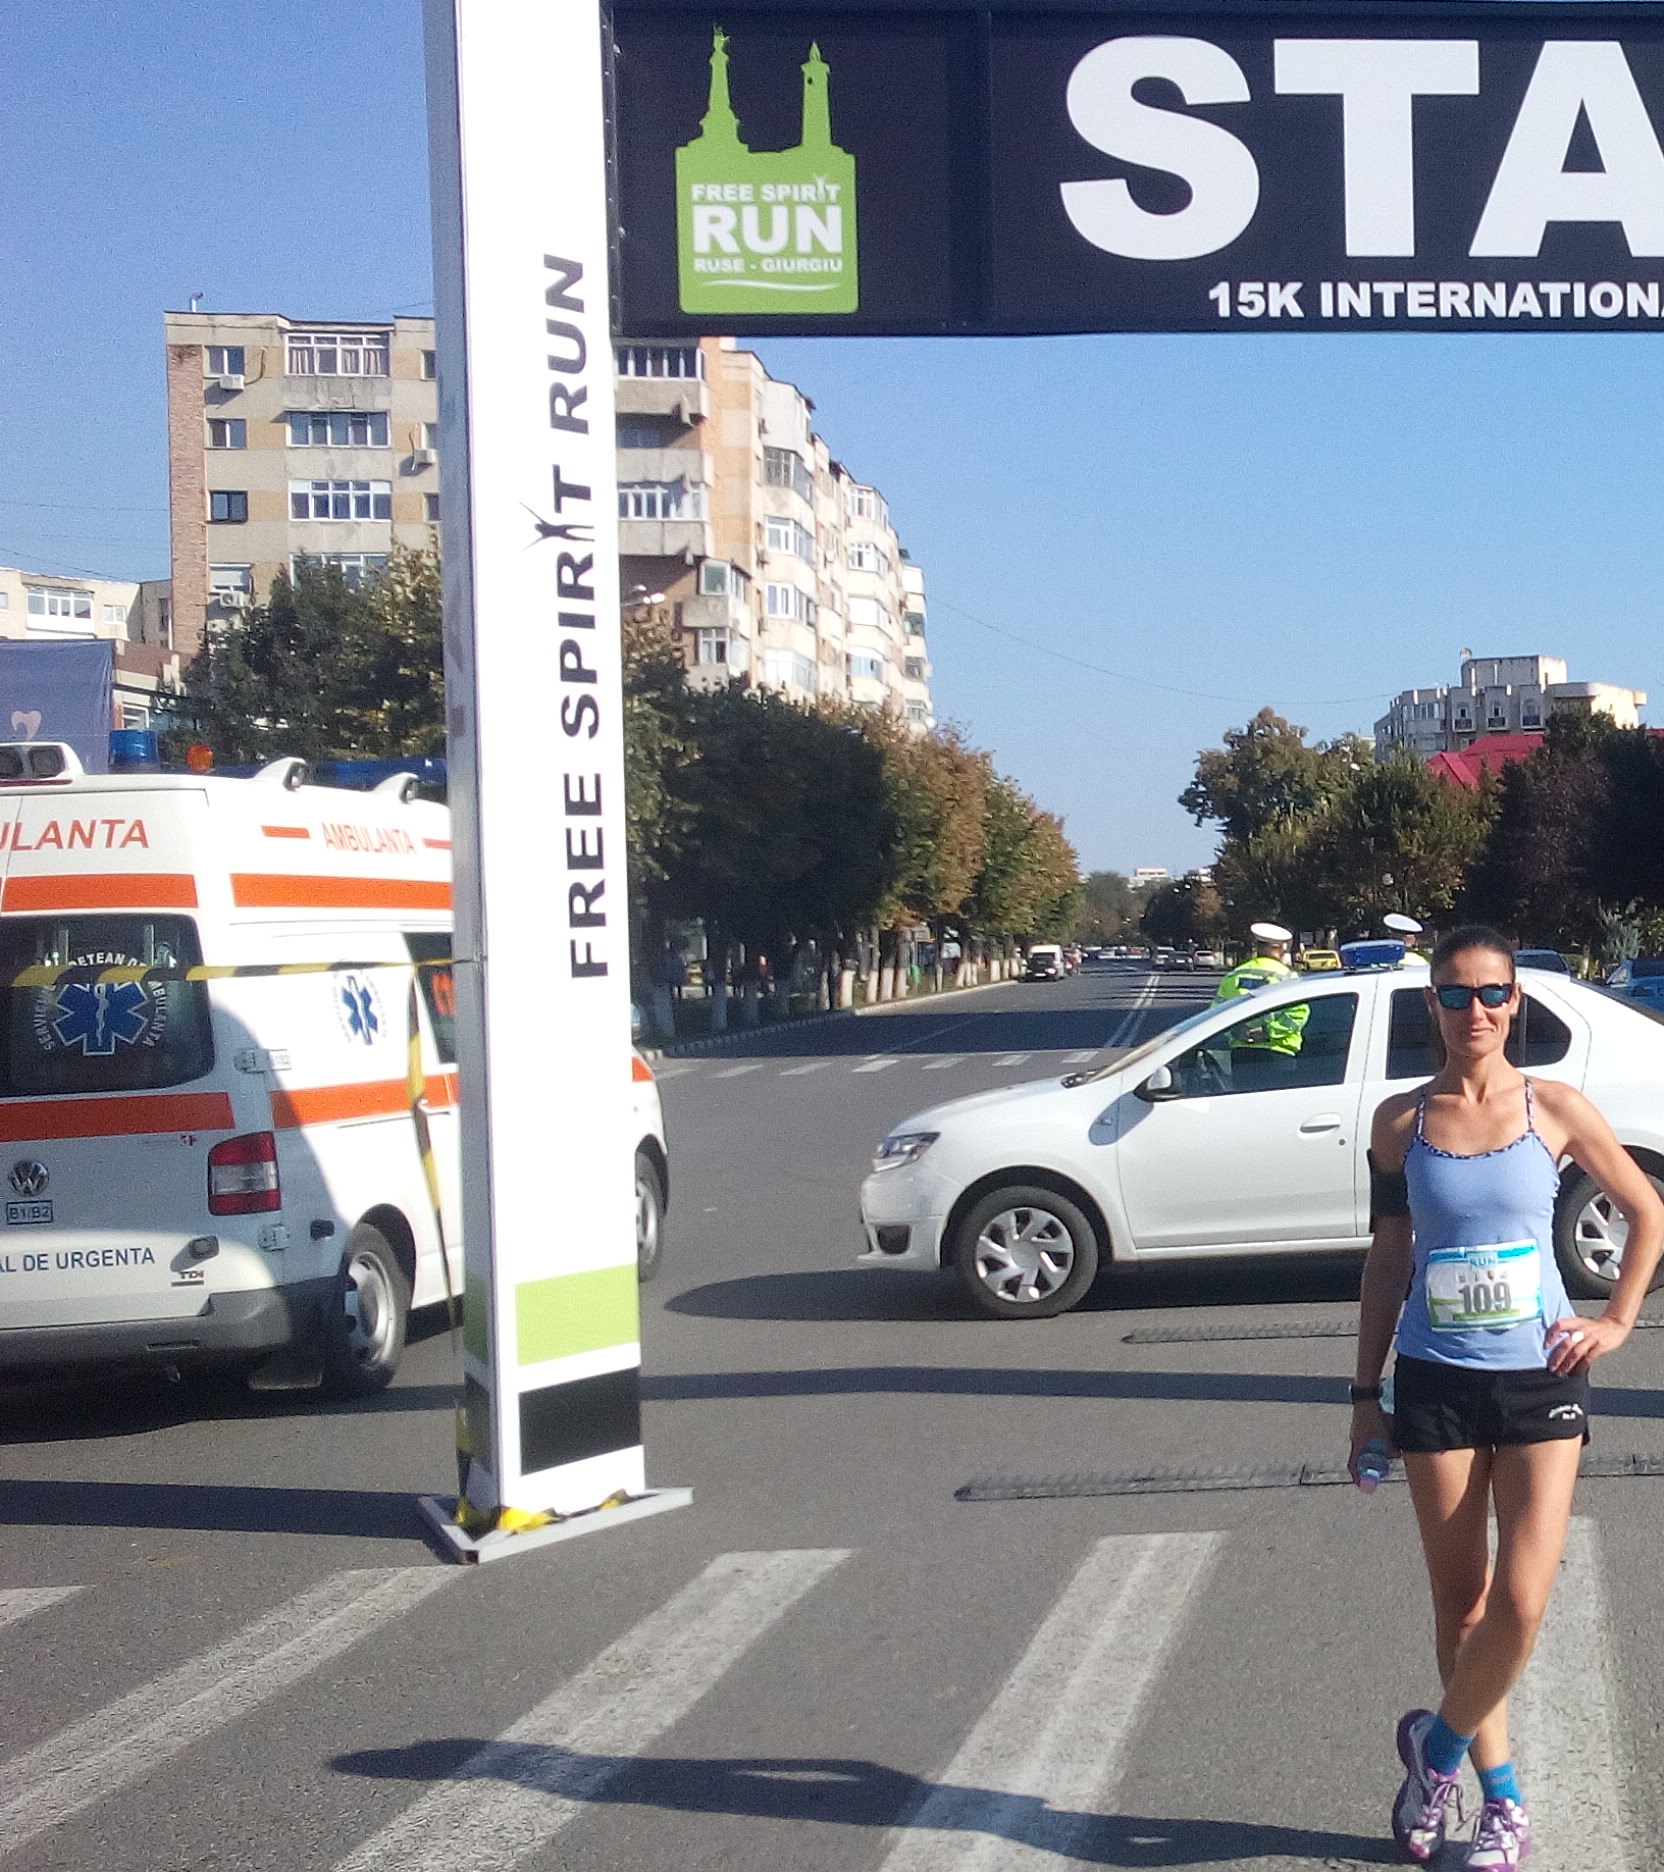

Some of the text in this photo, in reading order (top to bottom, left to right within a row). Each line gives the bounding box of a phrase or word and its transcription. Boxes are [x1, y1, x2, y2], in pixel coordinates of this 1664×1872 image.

[691, 174, 842, 203] FREE SPIRIT
[692, 204, 844, 255] RUN
[693, 257, 746, 273] RUSE
[760, 257, 844, 273] GIURGIU
[1207, 281, 1304, 319] 15K
[539, 253, 609, 978] FREE SPIRIT RUN
[321, 822, 417, 855] AMBULANTA
[9, 1206, 50, 1220] B1/B2
[23, 1253, 49, 1272] DE
[56, 1247, 156, 1270] URGENTA
[1458, 1281, 1512, 1315] 109
